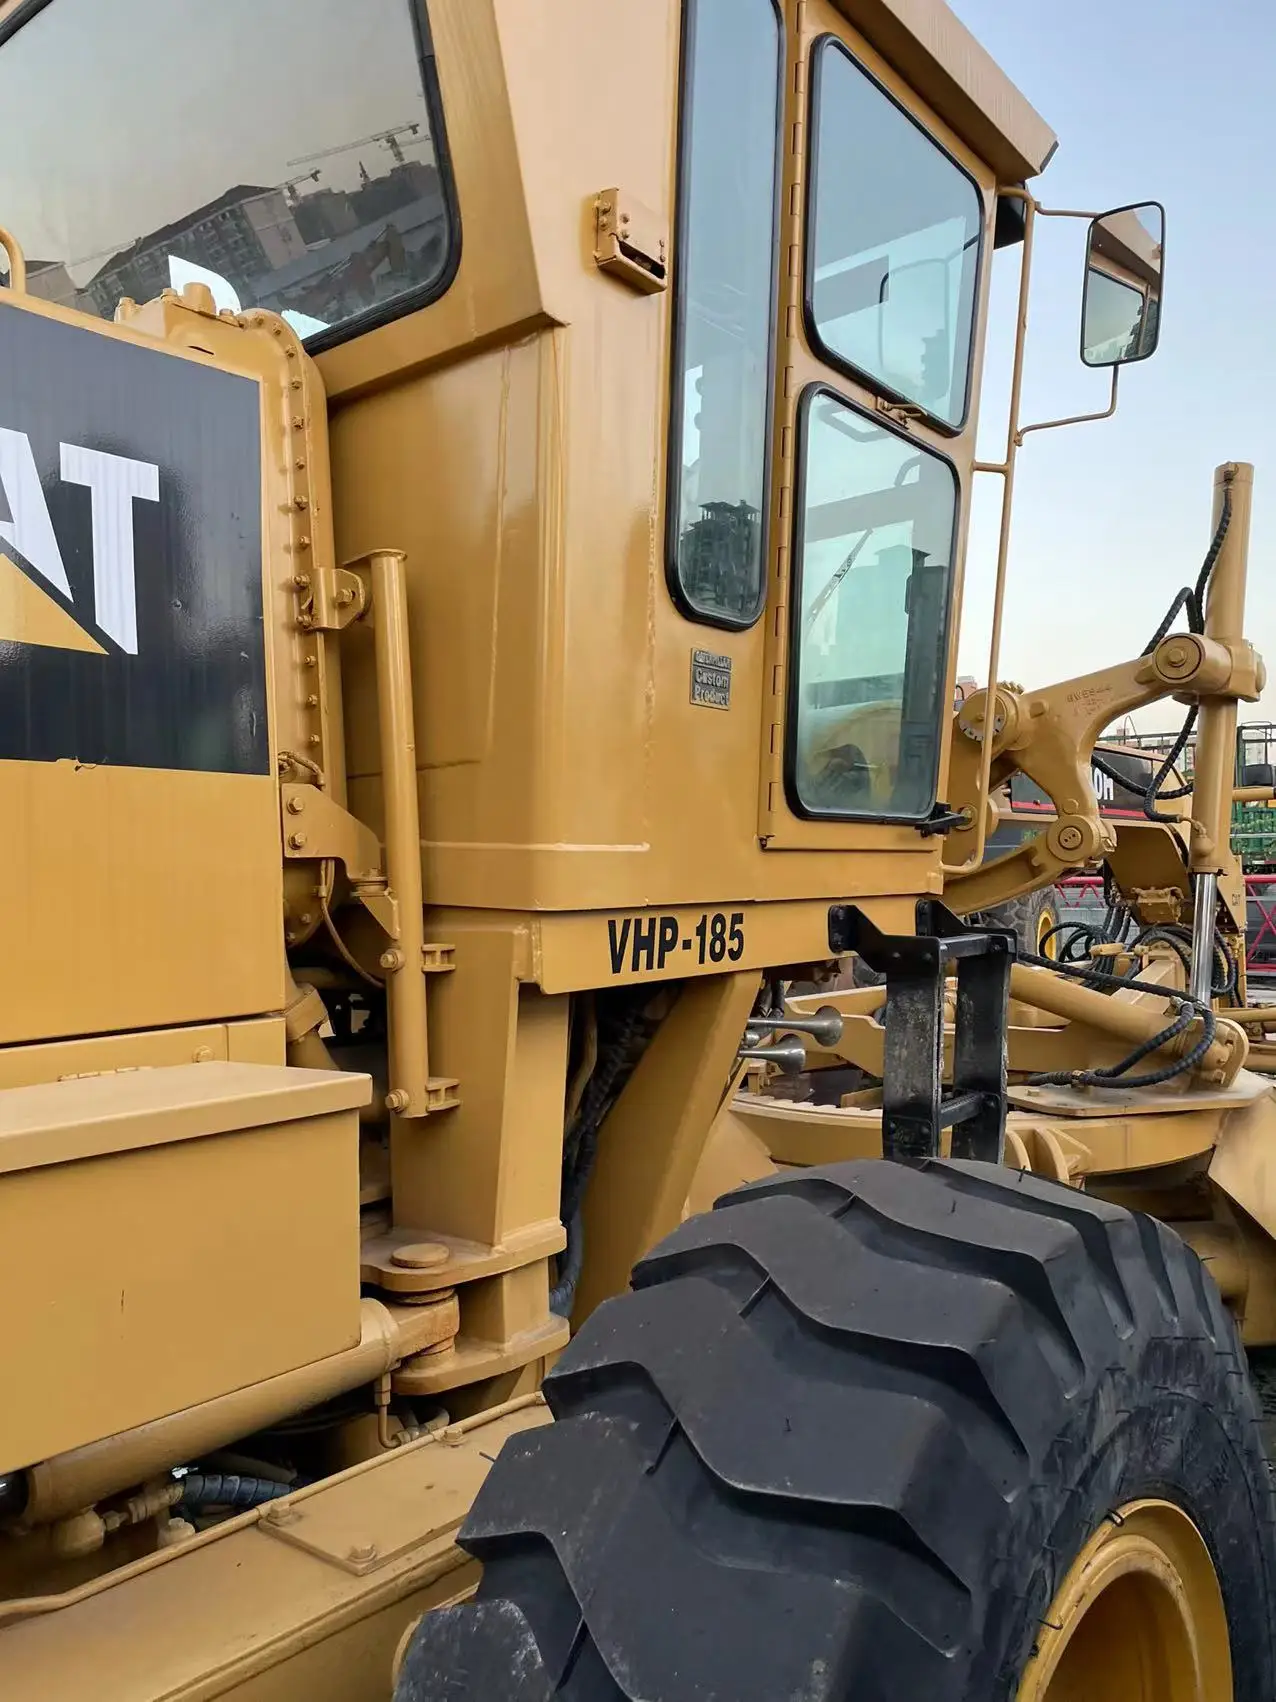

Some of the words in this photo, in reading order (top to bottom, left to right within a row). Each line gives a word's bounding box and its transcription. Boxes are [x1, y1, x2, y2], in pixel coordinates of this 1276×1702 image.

[0, 427, 160, 655] AT
[694, 684, 729, 706] Product
[695, 668, 729, 688] Custom
[1093, 767, 1114, 801] 0H
[607, 912, 744, 974] VHP-185
